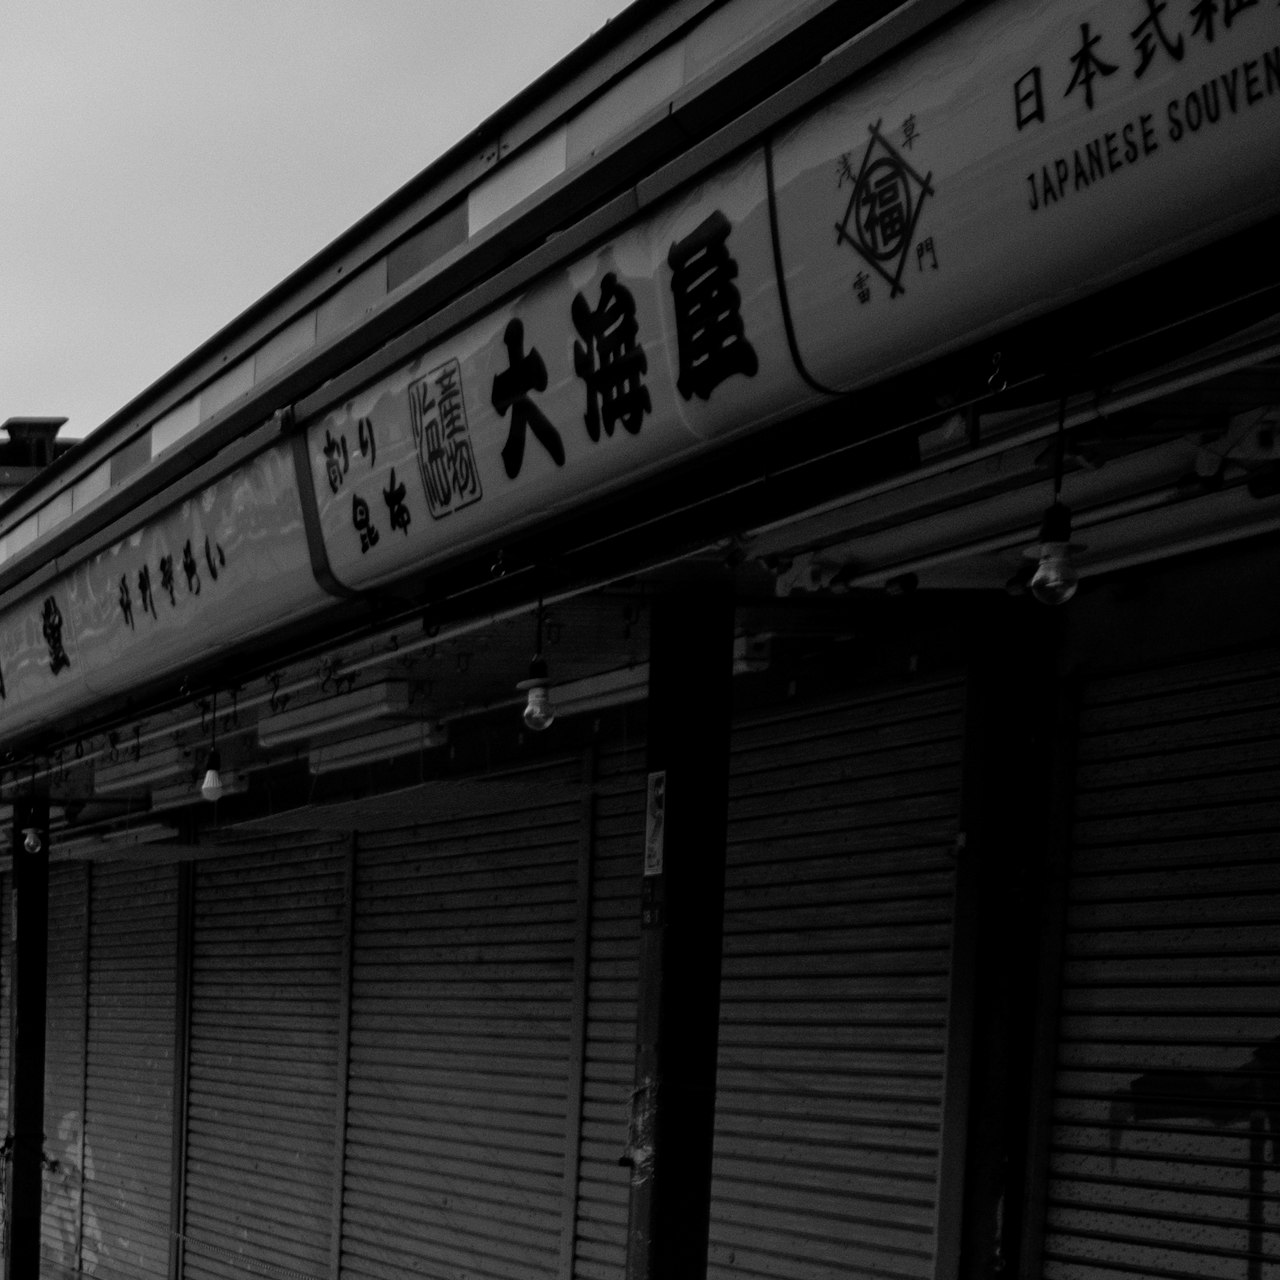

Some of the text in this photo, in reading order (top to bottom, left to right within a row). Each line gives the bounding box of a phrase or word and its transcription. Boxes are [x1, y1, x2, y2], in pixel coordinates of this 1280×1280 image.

[1028, 113, 1159, 212] JAPANESE
[860, 173, 906, 248] 福
[851, 236, 940, 305] 雷門
[490, 208, 759, 480] 大海屋
[321, 416, 378, 495] 削り
[351, 466, 411, 553] 昆布
